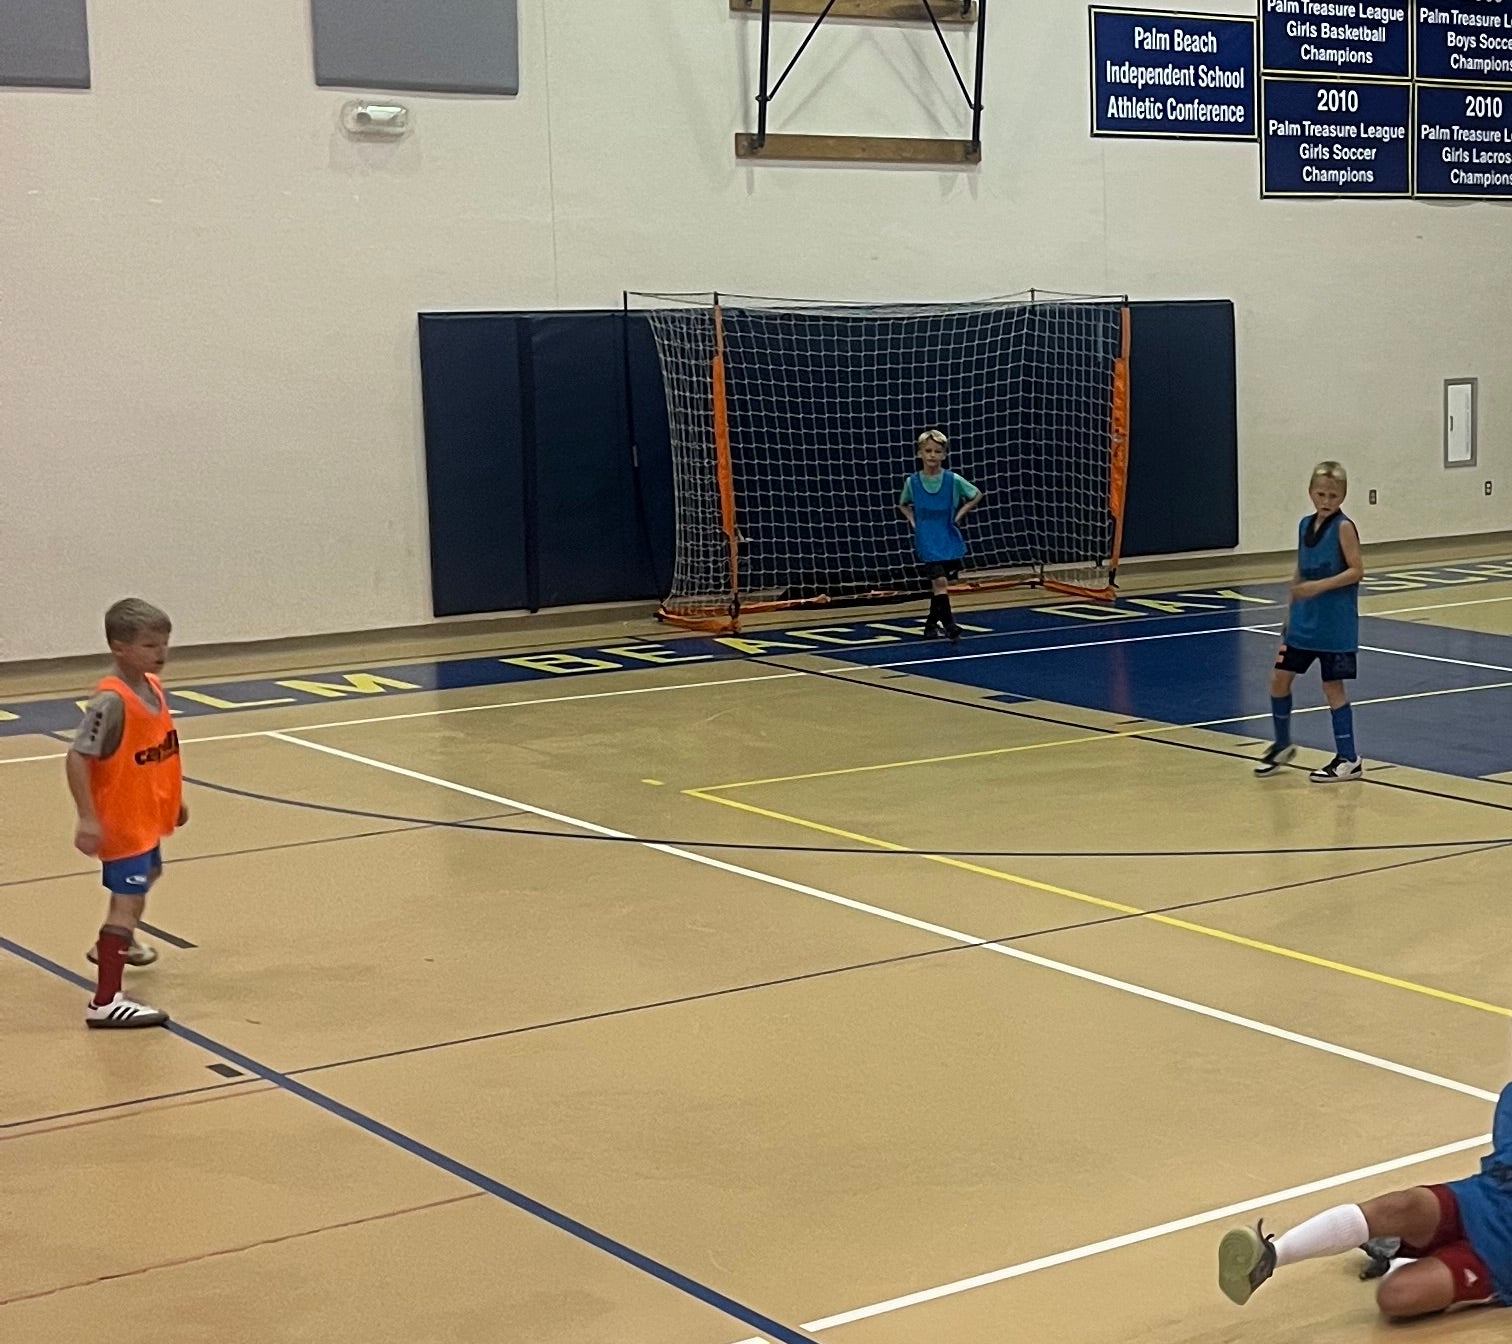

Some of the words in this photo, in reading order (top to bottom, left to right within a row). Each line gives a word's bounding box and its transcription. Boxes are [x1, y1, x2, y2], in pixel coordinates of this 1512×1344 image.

[1359, 3, 1405, 24] League
[1420, 7, 1450, 24] Palm
[1451, 9, 1501, 28] Treasure
[1134, 26, 1170, 51] Palm
[1174, 29, 1217, 53] Beach
[1286, 20, 1318, 38] Girls
[1320, 22, 1386, 42] Basketball
[1447, 31, 1477, 51] Boys
[1300, 44, 1373, 66] Champions
[1106, 60, 1195, 89] Independent
[1198, 65, 1245, 89] School
[1107, 96, 1163, 120] Athletic
[1167, 98, 1245, 122] Conference
[1317, 89, 1358, 113] 2010
[1465, 95, 1503, 118] 2010
[1269, 119, 1301, 136] Palm
[1302, 121, 1357, 138] Treasure
[1360, 123, 1405, 142] League
[1421, 124, 1450, 140] Palm
[1451, 126, 1501, 142] Treasure
[1299, 143, 1330, 160] Girls
[1333, 144, 1376, 160] Soccer
[1442, 147, 1470, 163] Girls
[1302, 166, 1374, 186] Champions
[499, 618, 993, 674] BEACH
[1030, 589, 1277, 621] DAY
